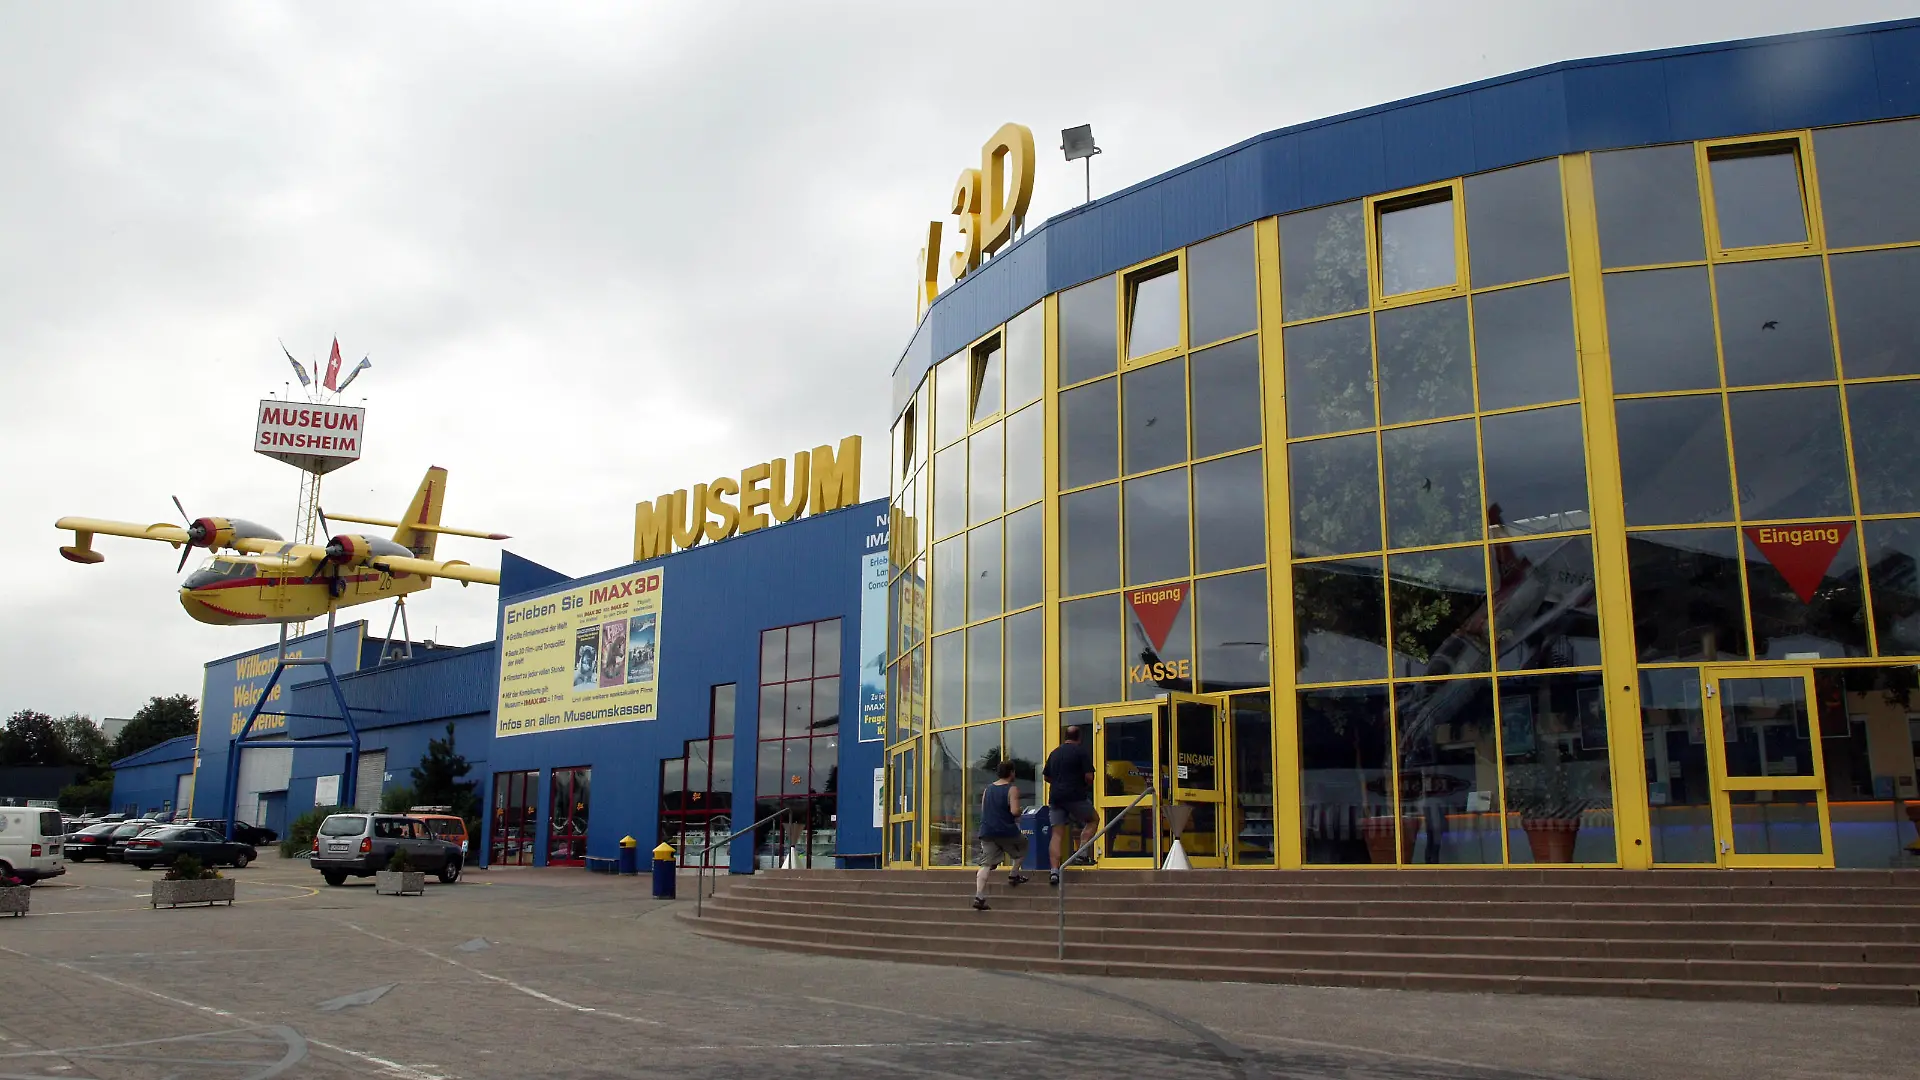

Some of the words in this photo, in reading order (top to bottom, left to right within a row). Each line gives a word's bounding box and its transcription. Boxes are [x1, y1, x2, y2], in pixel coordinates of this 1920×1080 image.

[261, 407, 358, 431] MUSEUM
[260, 431, 356, 451] SINSHEIM
[633, 435, 862, 564] MUSEUM
[1760, 528, 1839, 546] Eingang
[1133, 588, 1181, 605] Eingang
[507, 603, 556, 624] Erleben
[561, 595, 584, 611] Sie
[510, 632, 523, 641] Größte
[523, 626, 549, 637] Filmleinwand
[235, 650, 303, 680] Willkomen
[538, 668, 551, 676] vollen
[551, 665, 565, 674] Stunde
[1129, 659, 1190, 684] KASSE
[592, 692, 609, 700] weitere
[864, 703, 885, 711] IMAX
[231, 710, 287, 735] Bievenue
[500, 718, 522, 731] Infos
[524, 717, 536, 727] an
[538, 713, 560, 726] allen
[563, 703, 653, 723] Museumskassen
[1178, 752, 1215, 766] EINGANG
[462, 841, 468, 850] P
